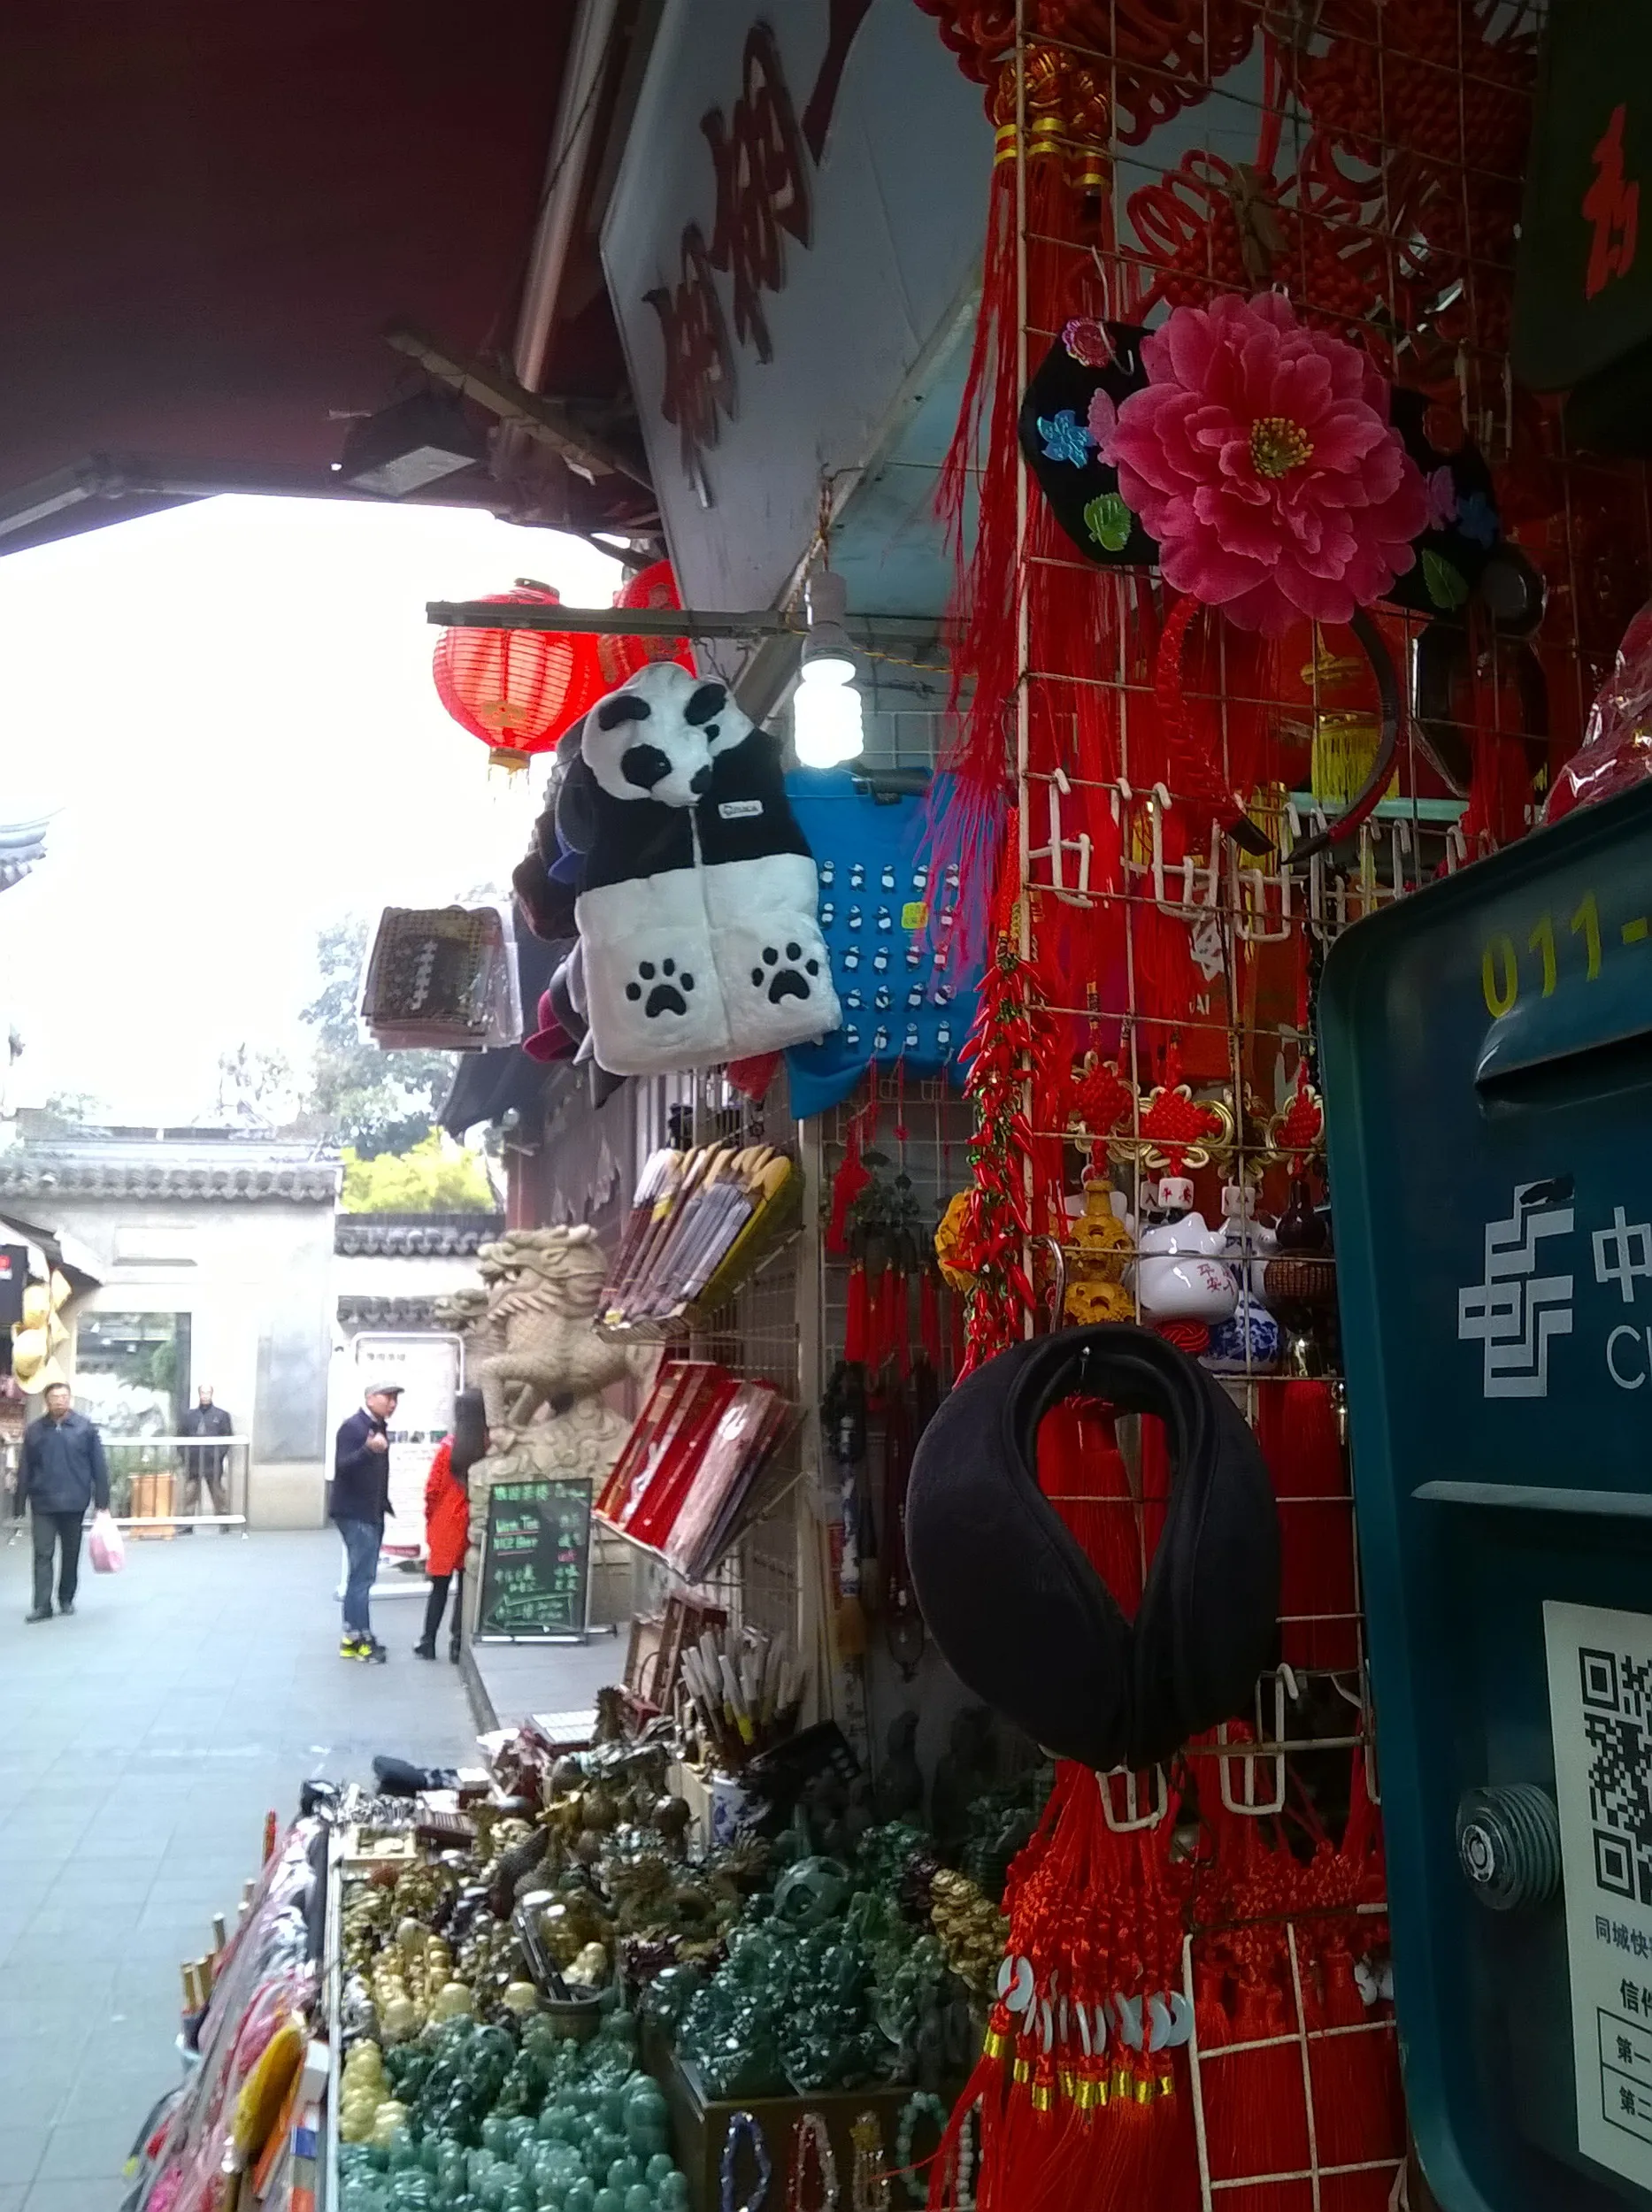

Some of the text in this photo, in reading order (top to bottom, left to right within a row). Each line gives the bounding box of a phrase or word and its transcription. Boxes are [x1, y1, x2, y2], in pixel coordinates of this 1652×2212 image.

[1606, 1324, 1652, 1390] C
[1595, 1914, 1652, 1960] 同城快
